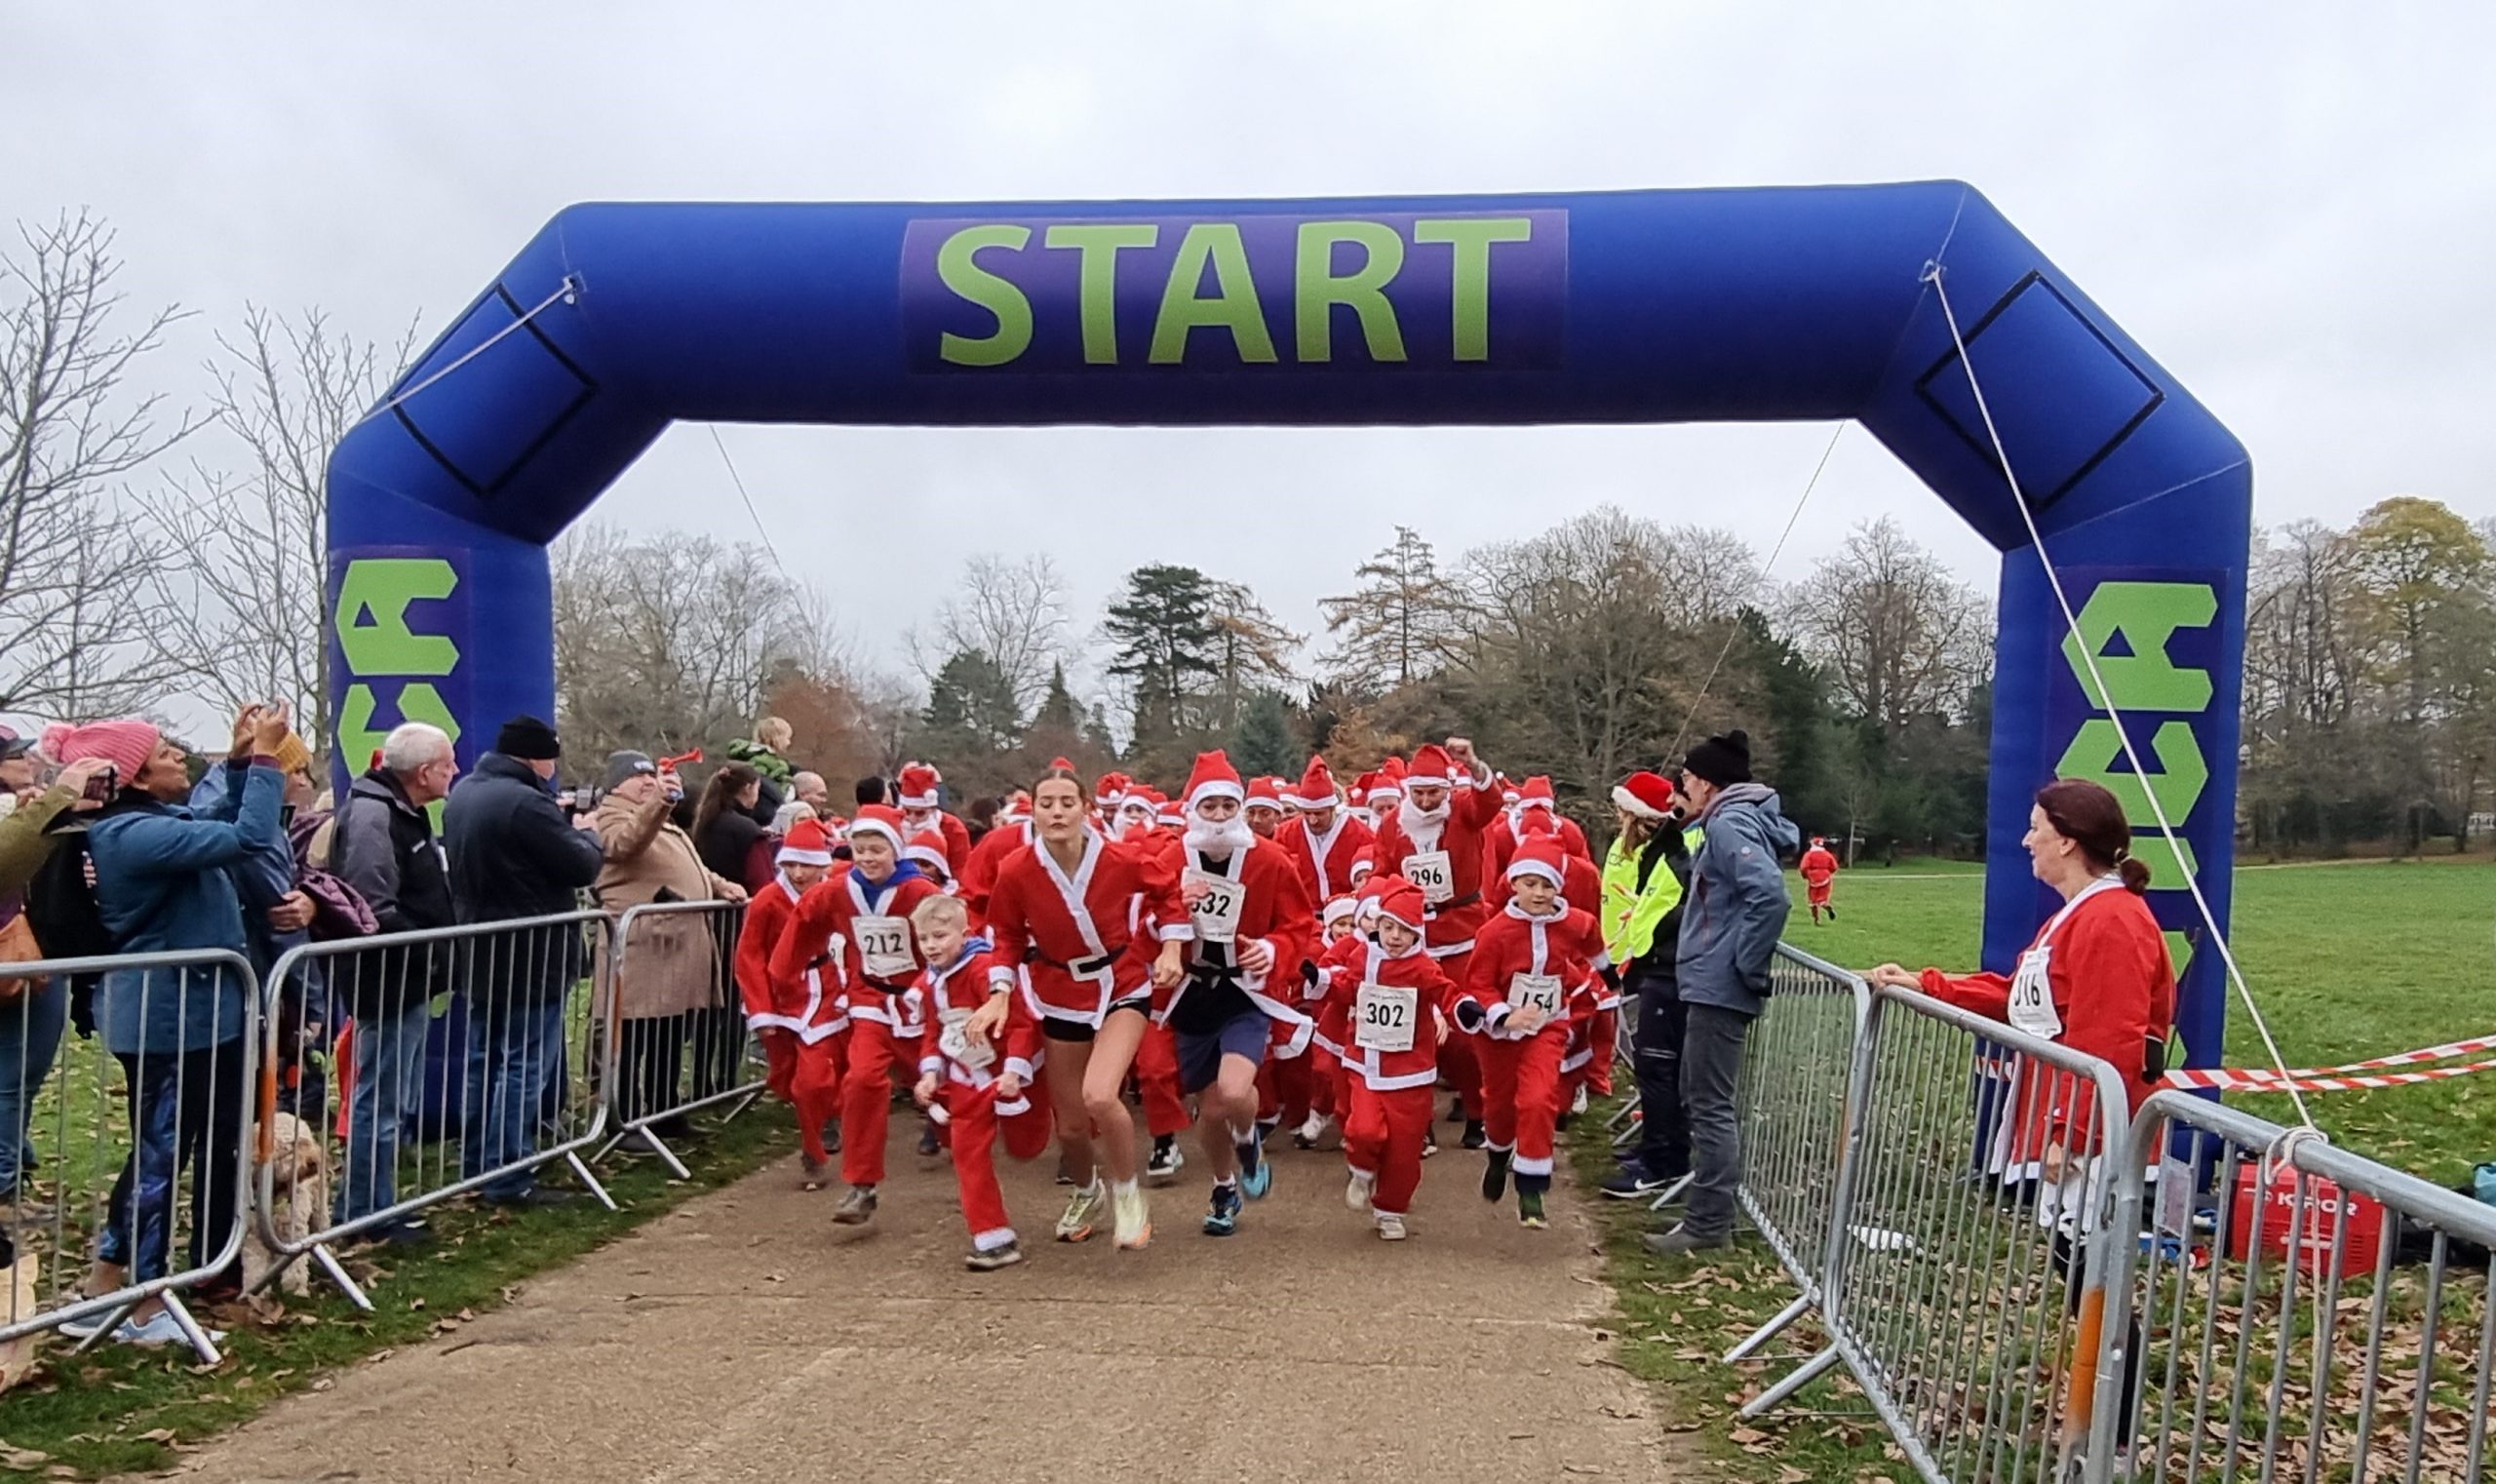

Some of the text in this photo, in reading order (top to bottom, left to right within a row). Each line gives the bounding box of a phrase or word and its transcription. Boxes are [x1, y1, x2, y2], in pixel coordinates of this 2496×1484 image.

[938, 218, 1531, 366] START
[1411, 867, 1442, 886] 296
[864, 933, 904, 955] 212
[1521, 992, 1554, 1014] 154
[1366, 1002, 1404, 1027] 302
